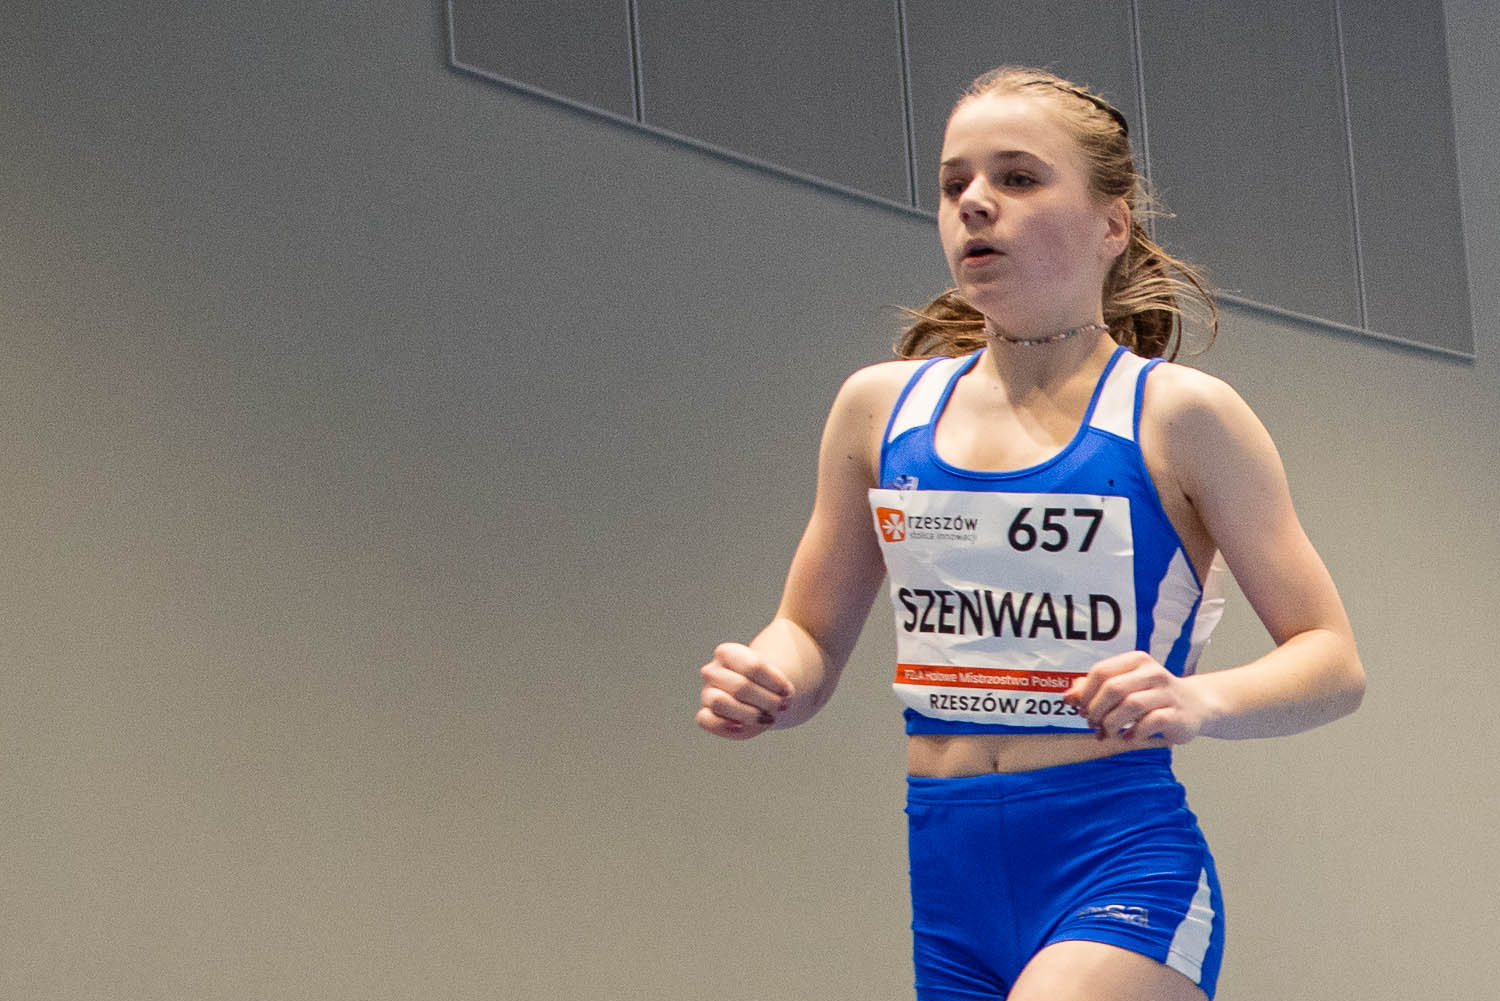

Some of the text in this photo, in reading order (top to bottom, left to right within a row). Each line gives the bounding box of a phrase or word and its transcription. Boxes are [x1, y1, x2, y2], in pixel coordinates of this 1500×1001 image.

[908, 514, 978, 531] rzeszów
[1008, 507, 1104, 552] 657
[898, 587, 1122, 642] SZENWALD
[959, 672, 1029, 687] Mistrzostwa
[1031, 676, 1069, 689] Polski
[930, 693, 1080, 716] RZESZÓW 2023
